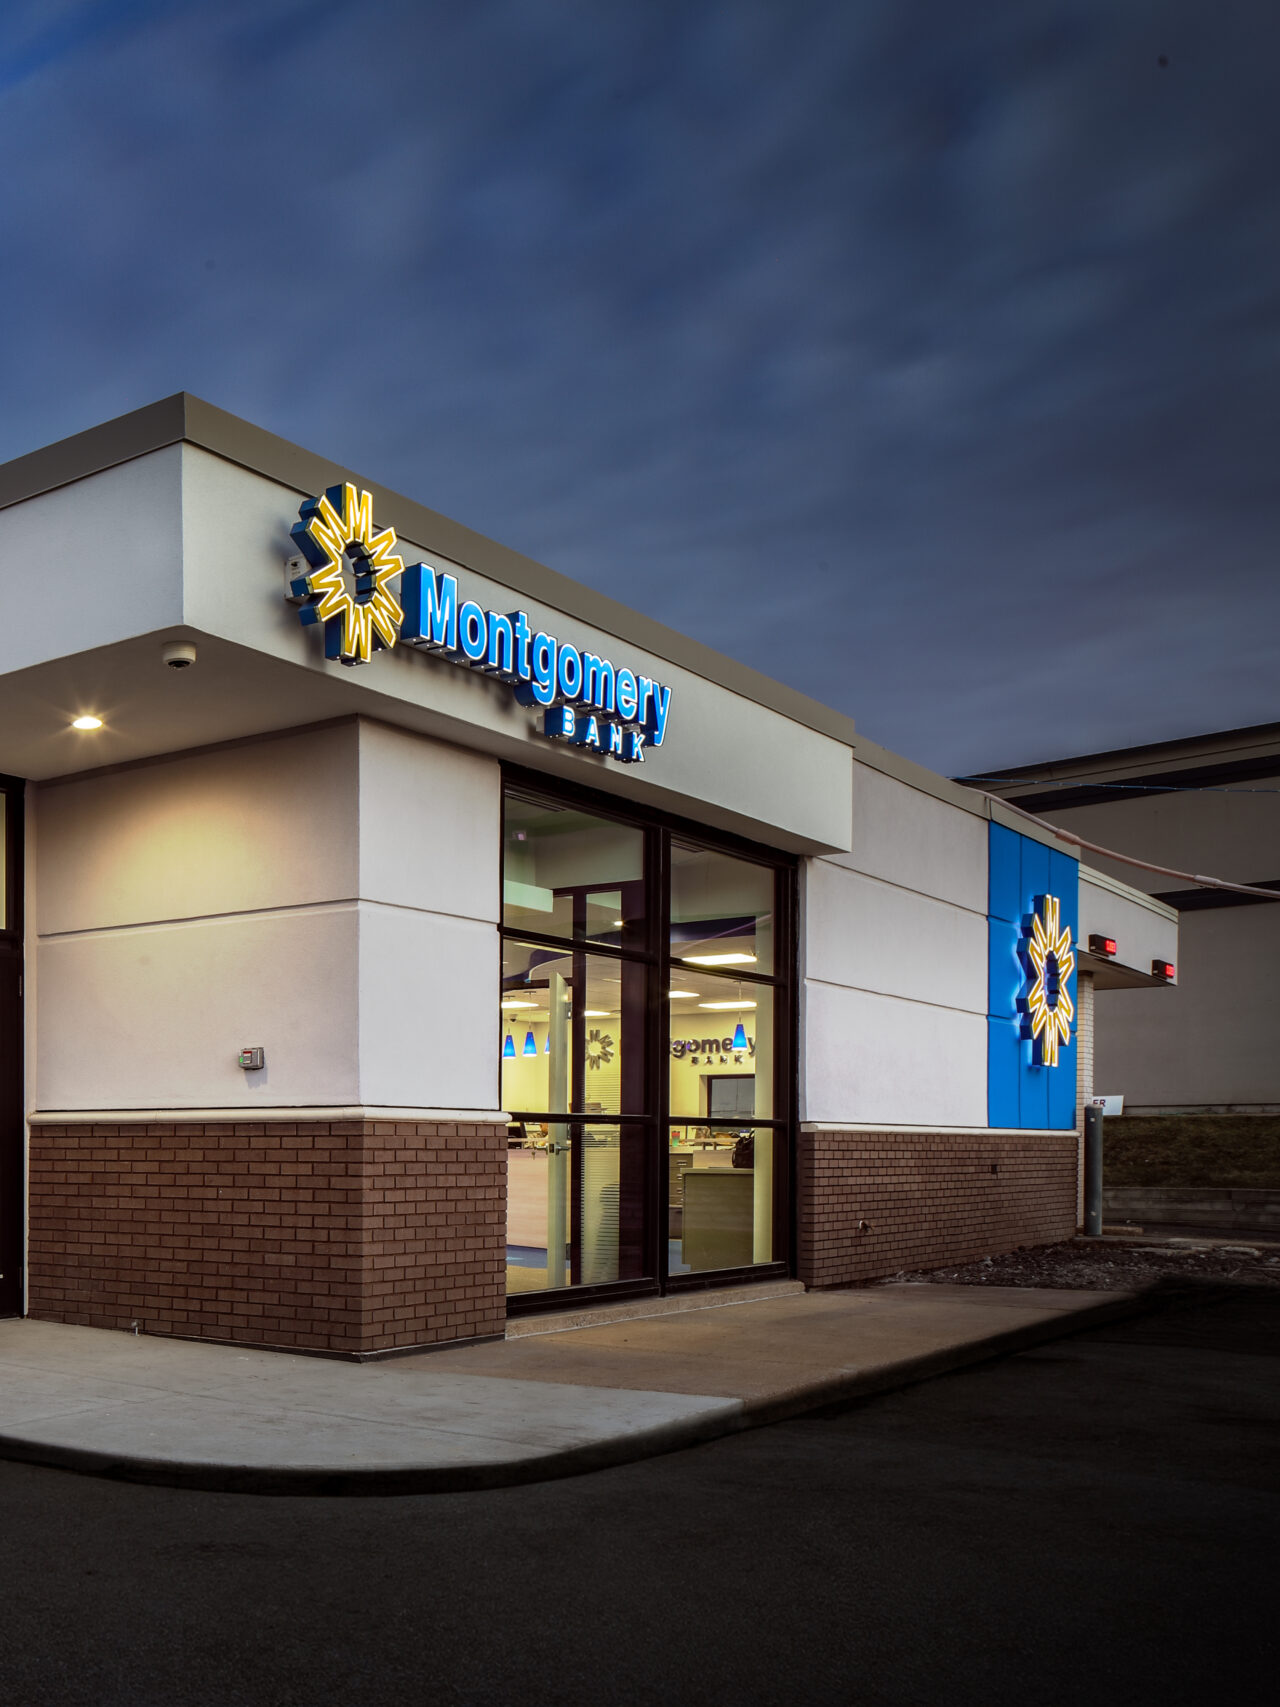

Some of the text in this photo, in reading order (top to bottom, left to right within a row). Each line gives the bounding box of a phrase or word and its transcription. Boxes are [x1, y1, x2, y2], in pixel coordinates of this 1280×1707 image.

[420, 562, 671, 746] Montgomery
[562, 706, 645, 762] BANK
[691, 1054, 743, 1065] BANK
